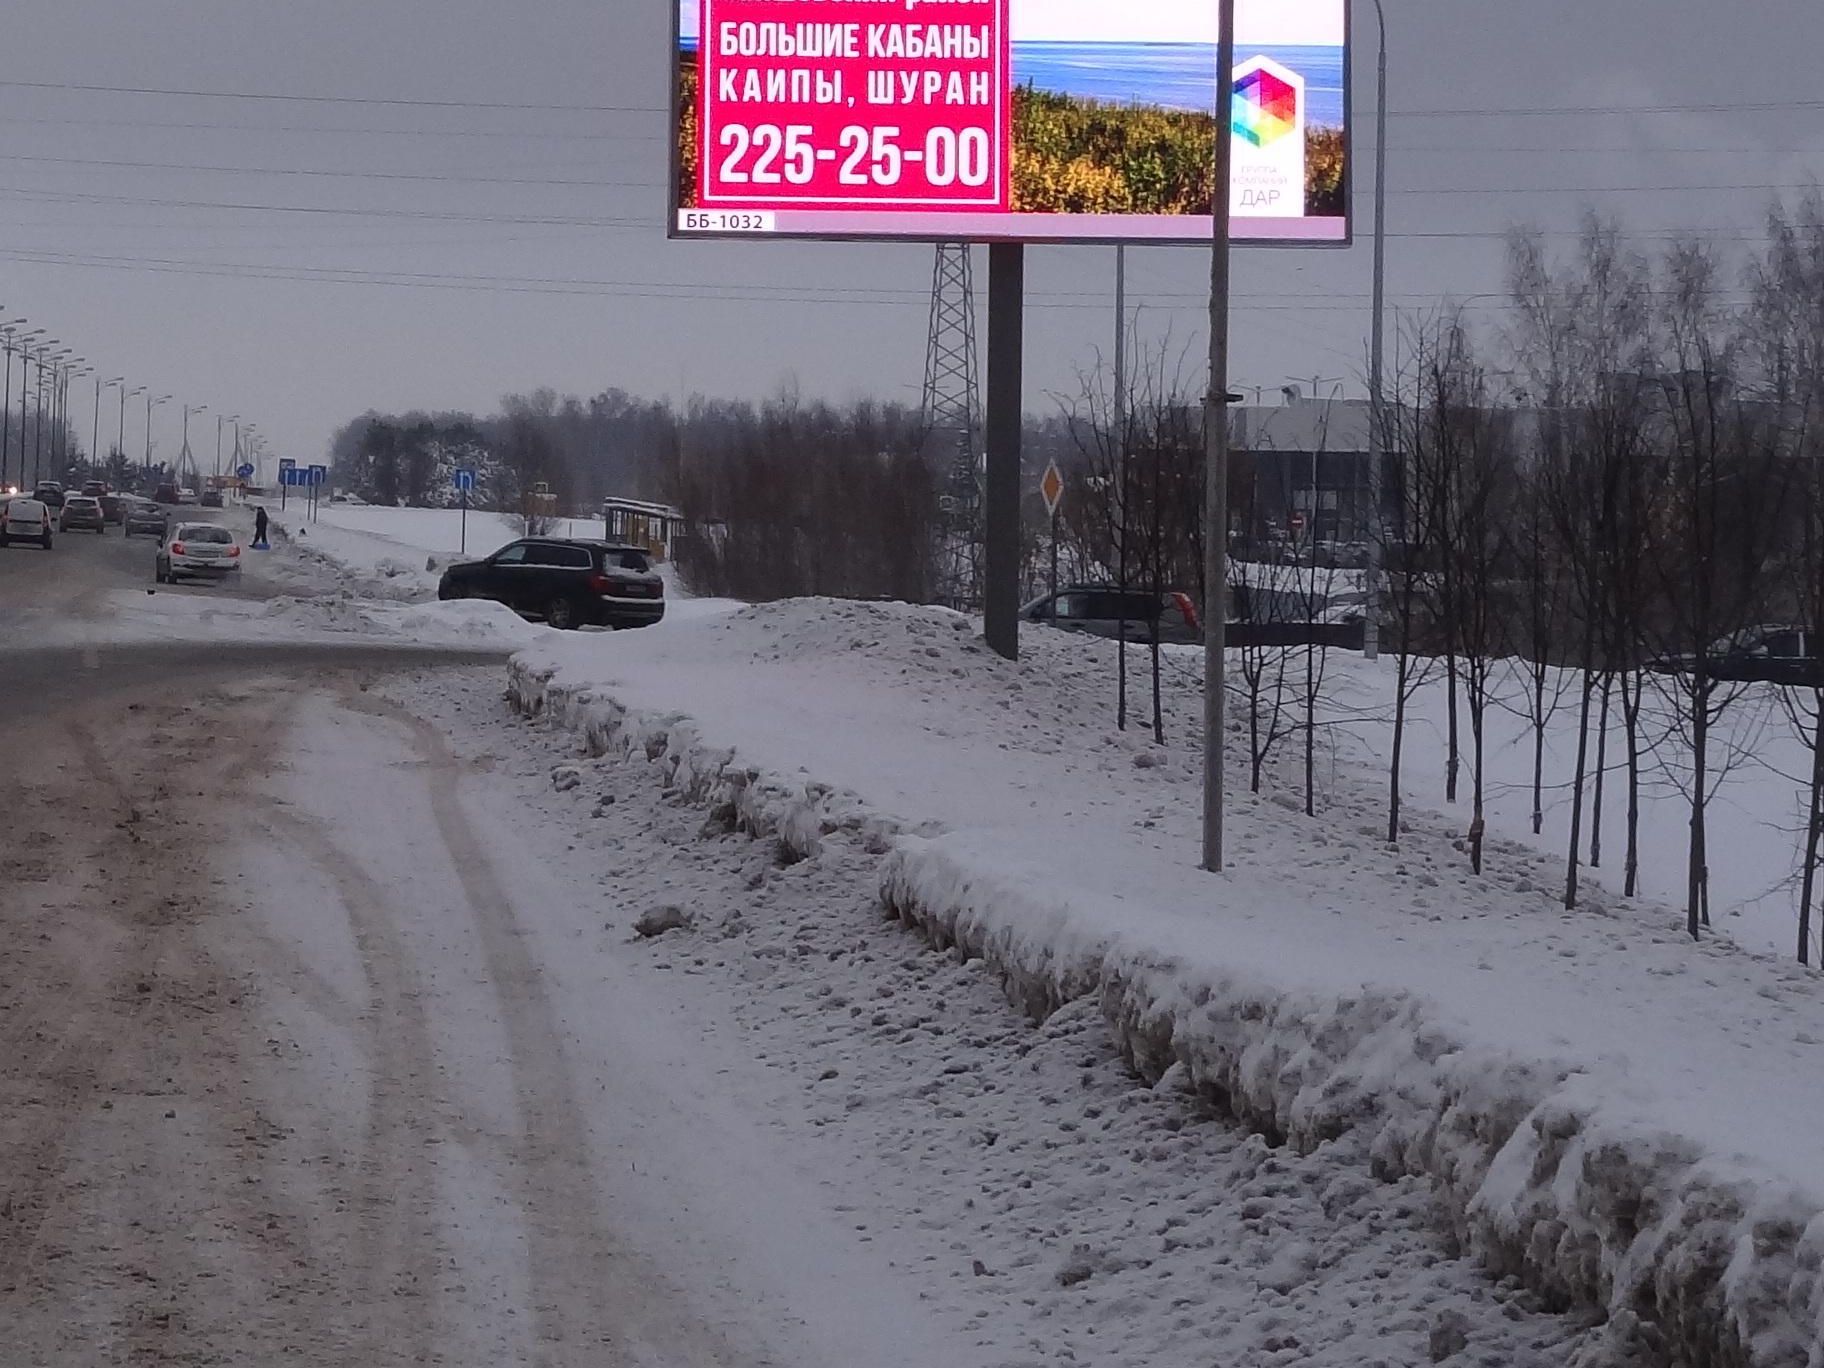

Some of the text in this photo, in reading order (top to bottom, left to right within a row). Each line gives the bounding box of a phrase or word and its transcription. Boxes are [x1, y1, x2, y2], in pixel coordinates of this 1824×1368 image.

[720, 21, 989, 59] БОЛЬШИЕ КАБАНЫ
[719, 68, 989, 108] КАИПЫ, ШУРАН
[719, 124, 989, 186] 225-25-00
[1239, 189, 1281, 208] ДАР
[687, 214, 763, 229] ББ-1032
